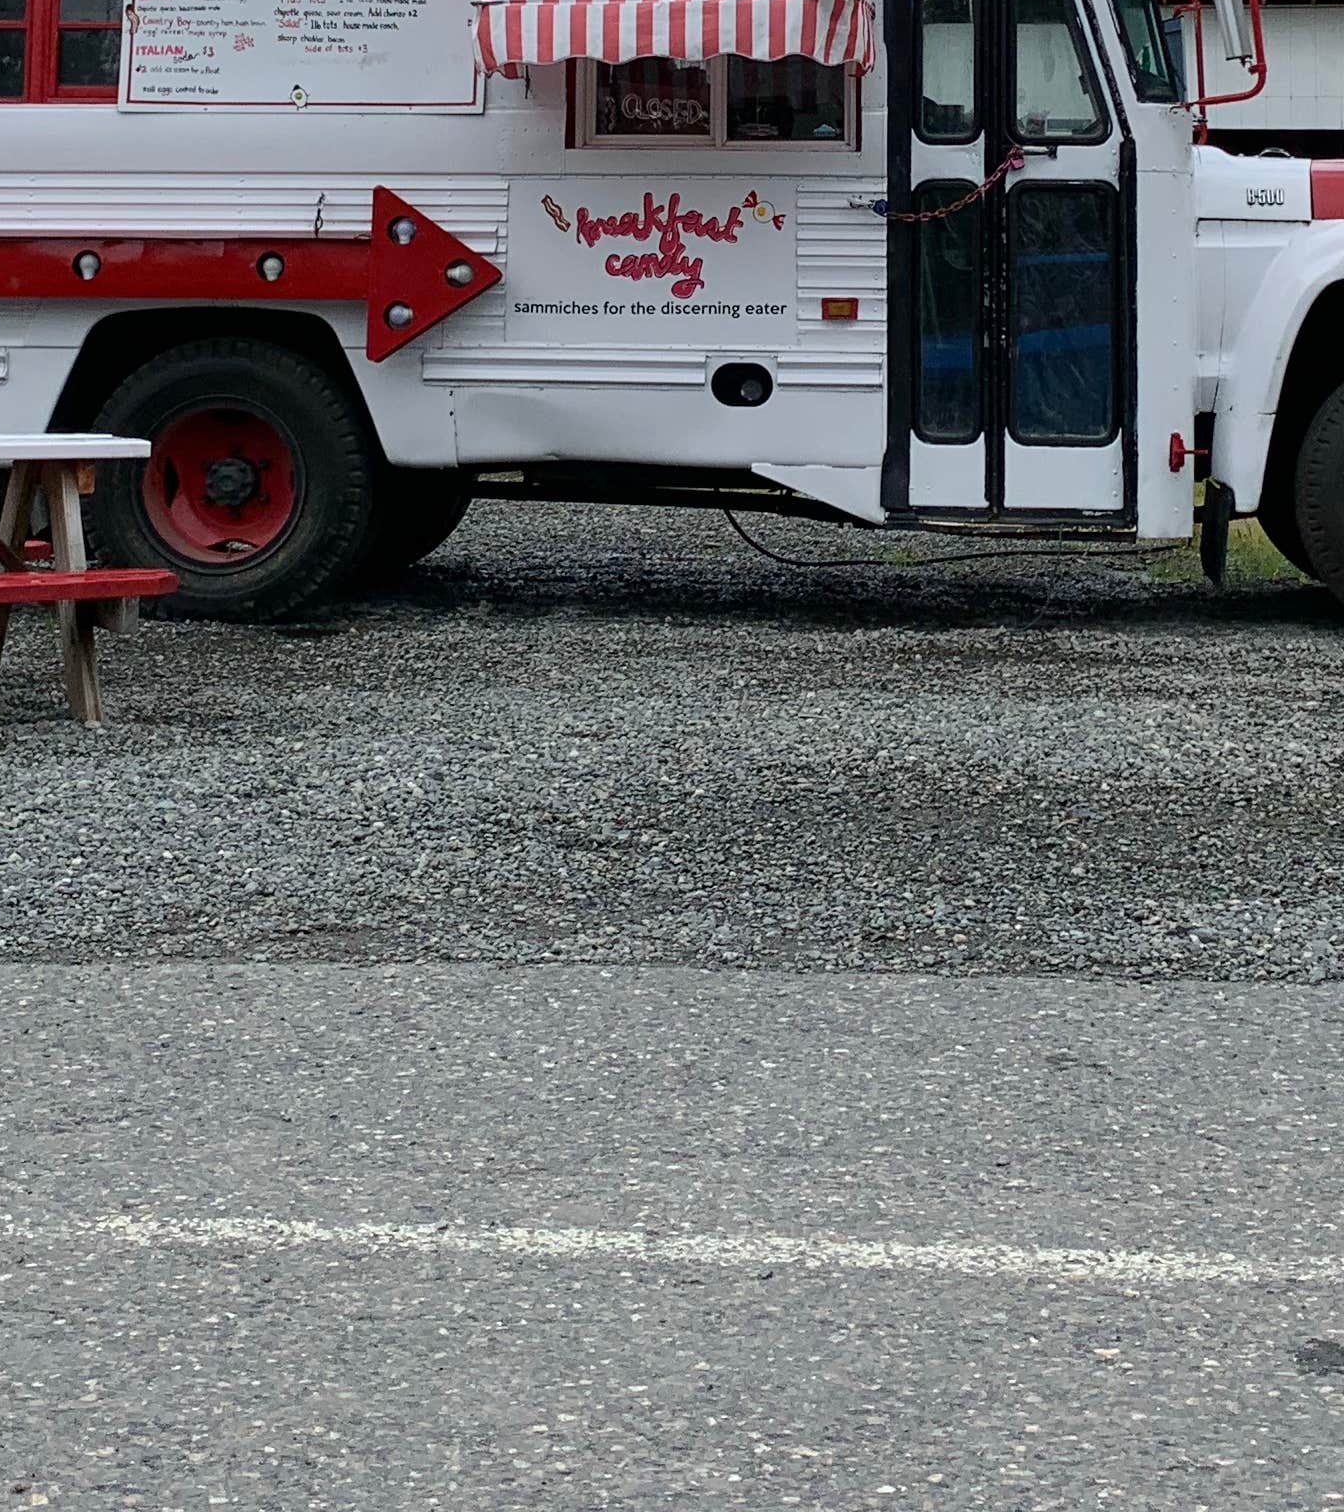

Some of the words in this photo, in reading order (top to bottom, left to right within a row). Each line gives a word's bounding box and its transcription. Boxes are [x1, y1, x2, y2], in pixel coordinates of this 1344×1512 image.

[135, 45, 184, 56] ITALIAN
[621, 93, 705, 124] CLOSED
[575, 192, 744, 256] breakfast
[605, 242, 705, 299] candy
[514, 301, 599, 315] sammiches
[602, 301, 626, 315] for
[630, 301, 656, 315] the
[660, 301, 741, 319] discerning
[744, 302, 788, 315] eater
